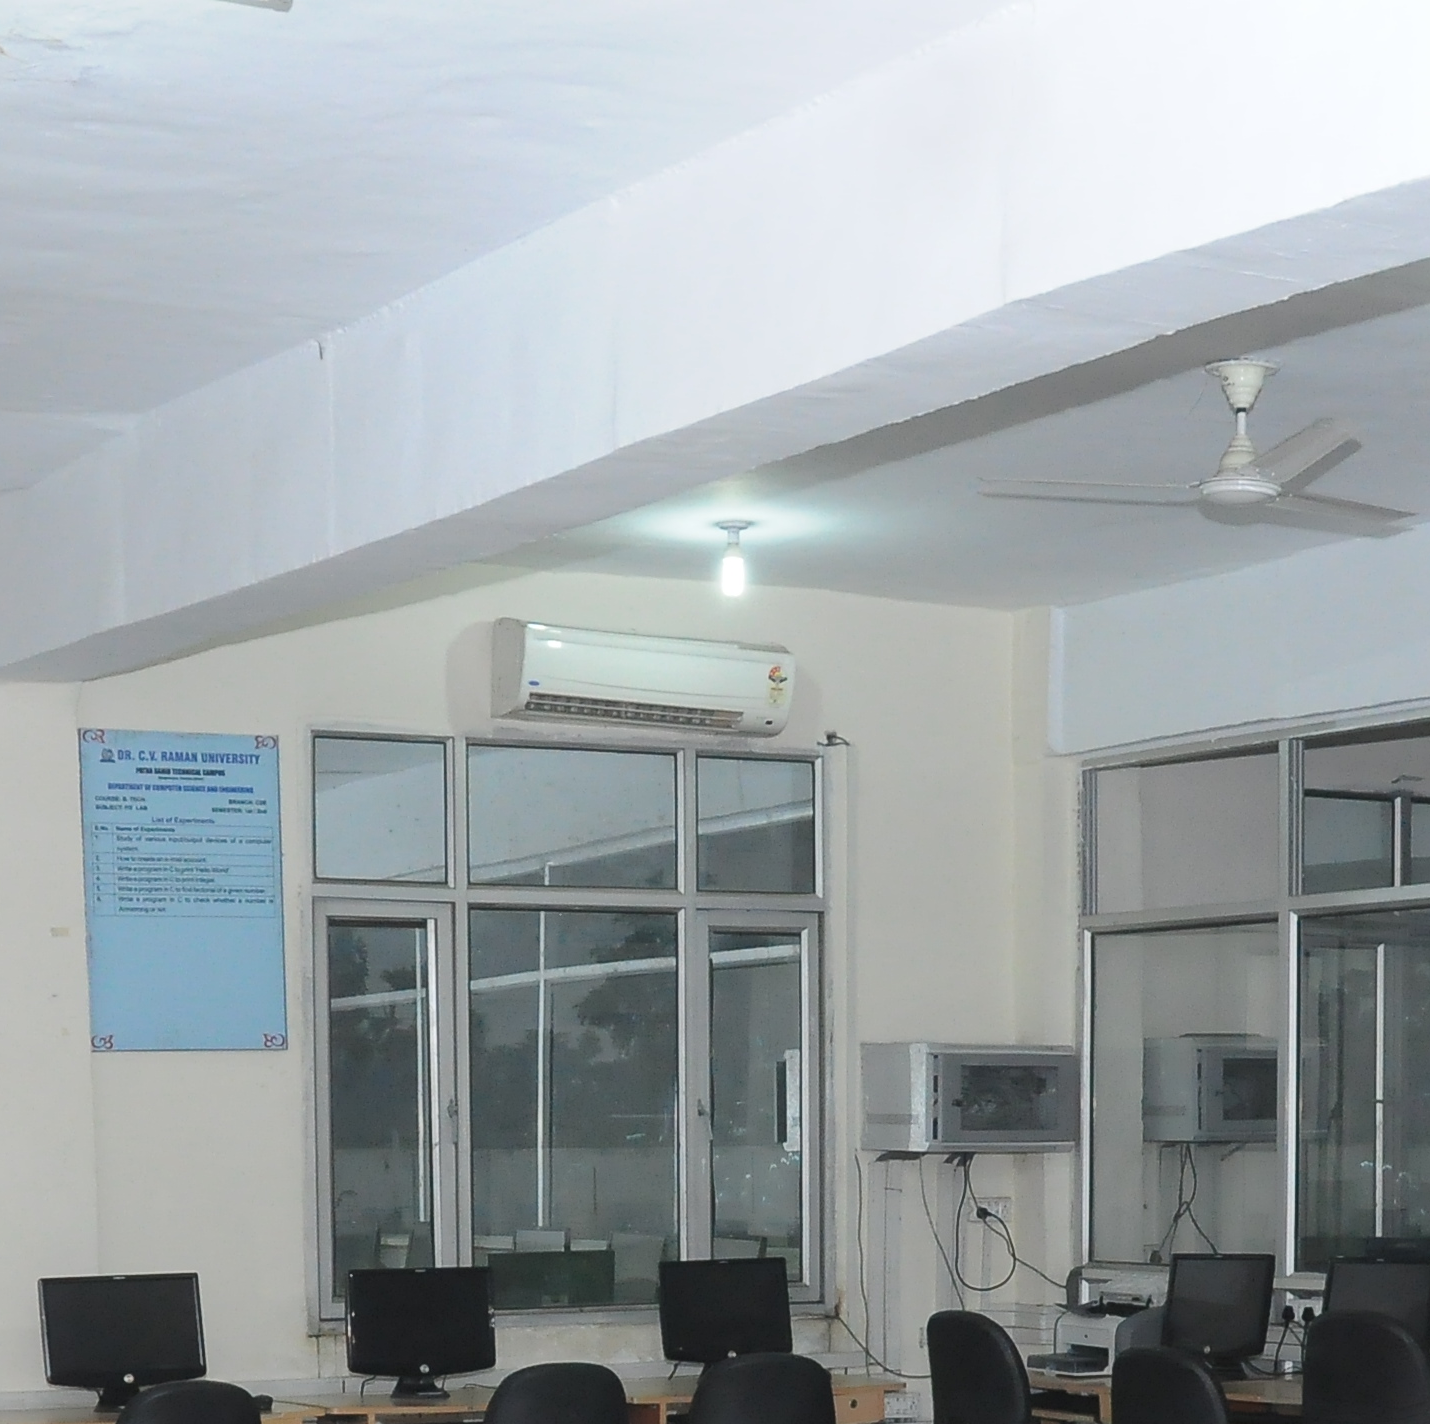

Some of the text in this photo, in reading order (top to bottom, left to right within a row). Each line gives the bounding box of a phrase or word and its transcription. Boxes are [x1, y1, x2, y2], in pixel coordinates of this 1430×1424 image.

[117, 750, 261, 765] DR. C.V. RAMAN UNIVERSITY
[108, 783, 142, 791] DEPARTMENT
[174, 817, 215, 825] Experiments
